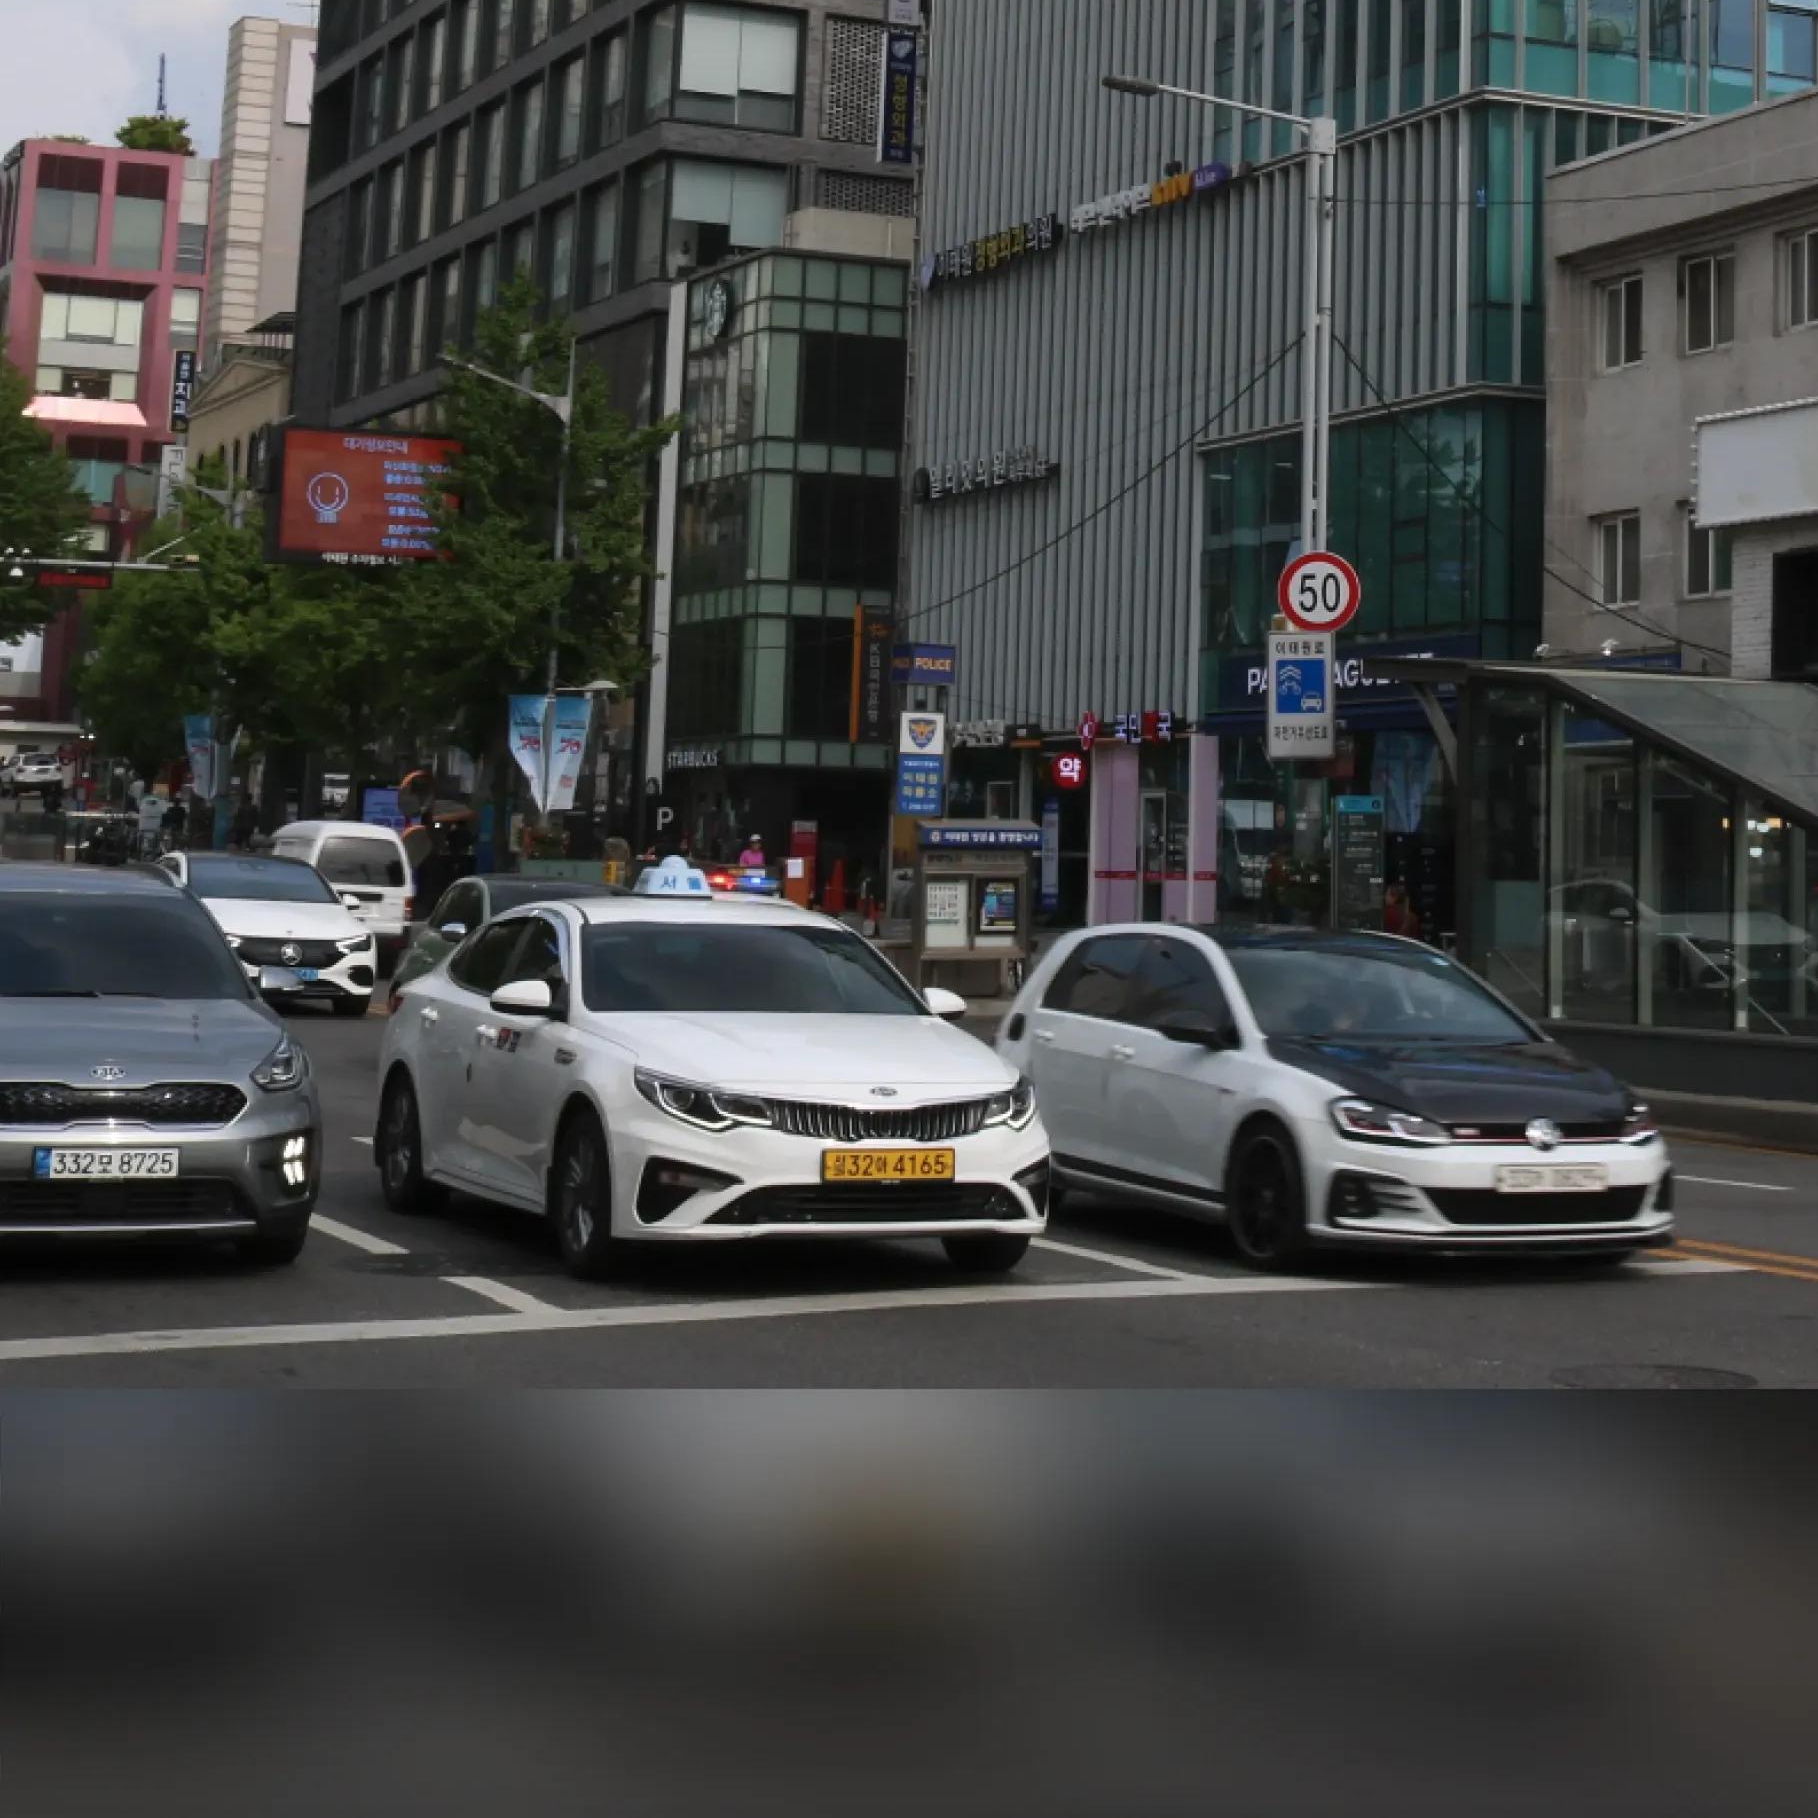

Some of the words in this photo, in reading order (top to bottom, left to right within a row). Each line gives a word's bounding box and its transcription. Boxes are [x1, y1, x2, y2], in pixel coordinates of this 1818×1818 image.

[1299, 573, 1341, 613] 50
[1275, 640, 1325, 656] 이태원로
[914, 657, 952, 672] POLICE
[1059, 758, 1081, 782] 약
[656, 806, 674, 831] P
[118, 1152, 174, 1174] 8725
[892, 1154, 945, 1175] 4165
